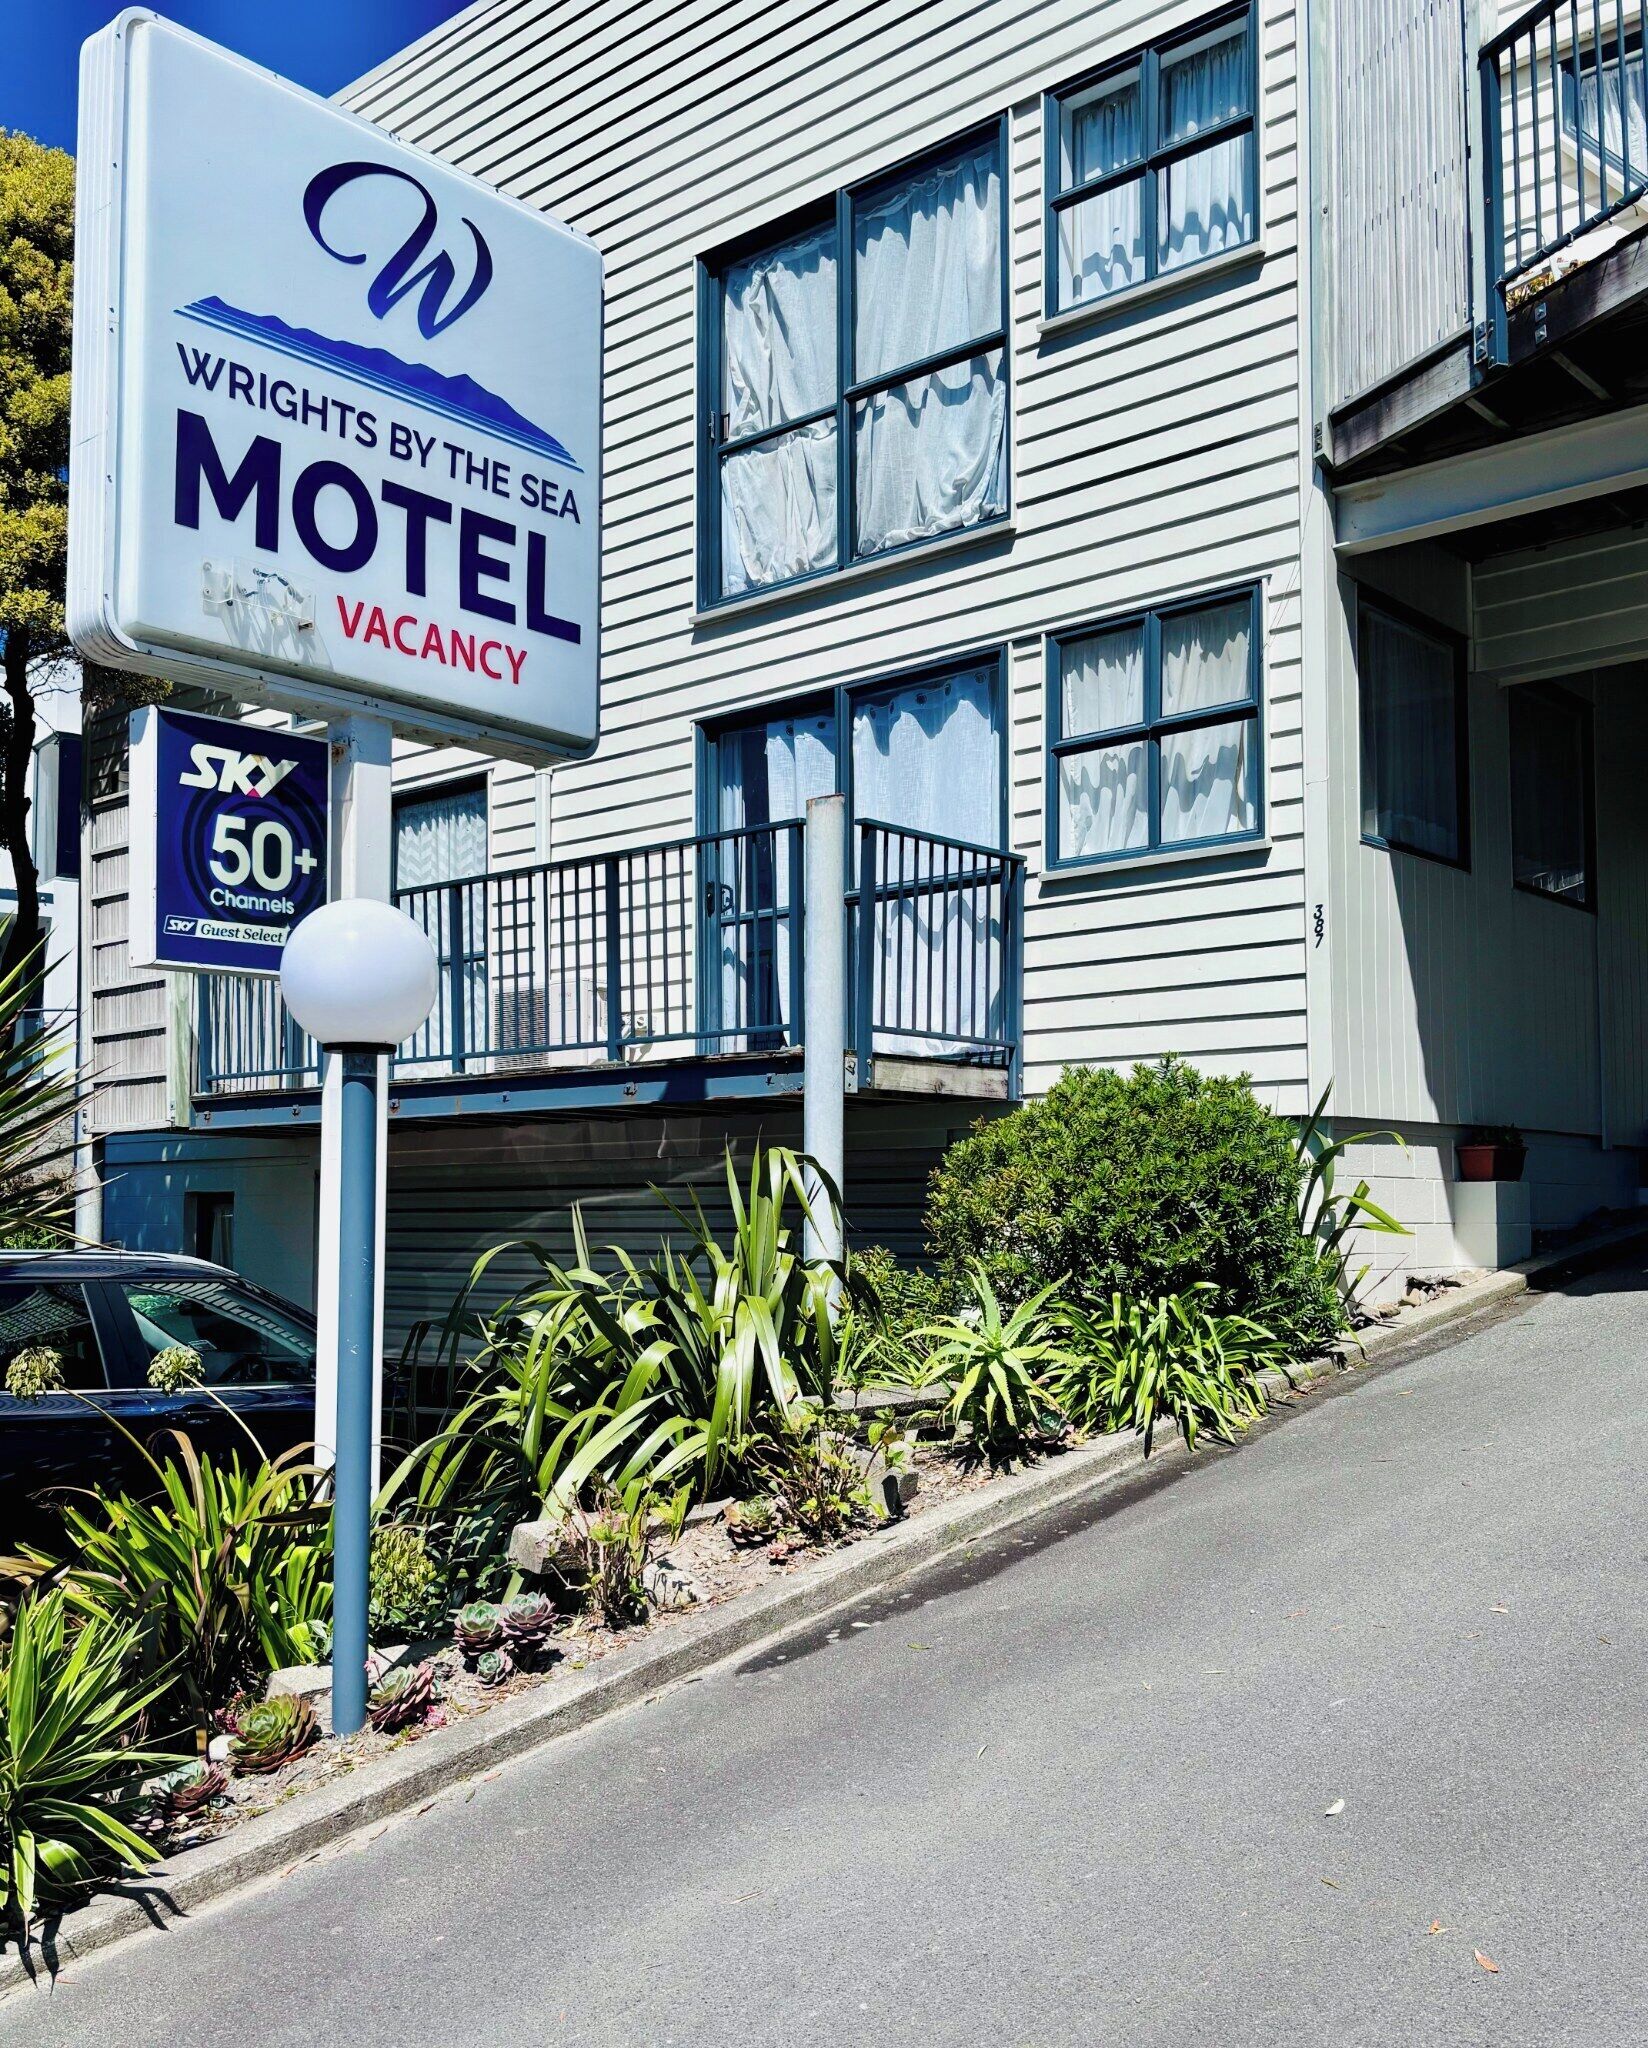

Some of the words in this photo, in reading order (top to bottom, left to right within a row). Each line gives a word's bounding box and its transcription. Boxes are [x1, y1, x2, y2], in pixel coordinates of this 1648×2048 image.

[176, 342, 378, 448] WRIGHTS
[389, 423, 438, 468] BY
[443, 441, 511, 498] THE
[520, 473, 582, 524] SEA
[174, 408, 582, 644] MOTEL
[337, 596, 529, 685] VACANCY
[179, 743, 299, 798] SKY
[209, 813, 318, 892] 50+
[200, 923, 240, 938] Guest
[242, 929, 283, 944] Select
[209, 887, 295, 915] Channels
[1313, 903, 1325, 949] 387
